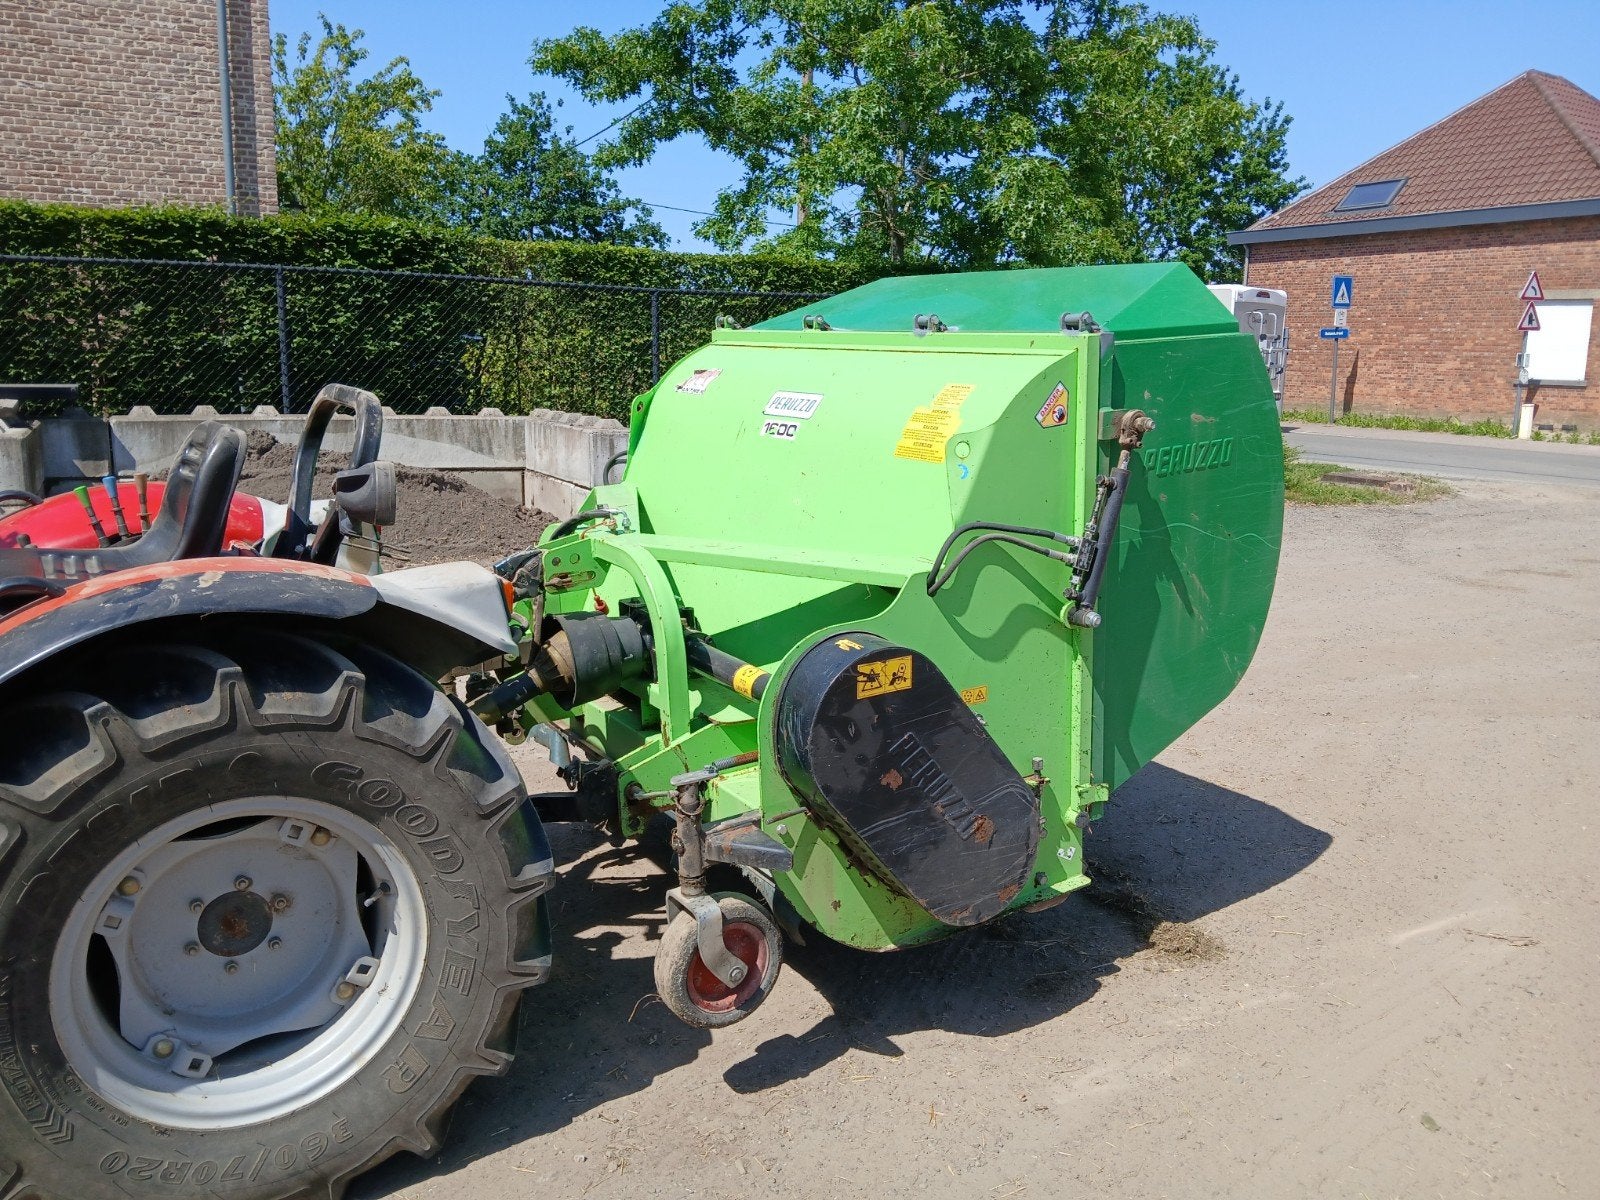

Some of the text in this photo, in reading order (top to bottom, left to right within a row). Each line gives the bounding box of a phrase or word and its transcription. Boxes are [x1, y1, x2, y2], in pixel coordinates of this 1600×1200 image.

[768, 396, 818, 413] PERUZZO
[1040, 388, 1062, 417] DANGER
[1144, 437, 1234, 478] PERUZZO
[311, 761, 480, 1094] GOODYEAR
[98, 1116, 354, 1186] 360/70R20
